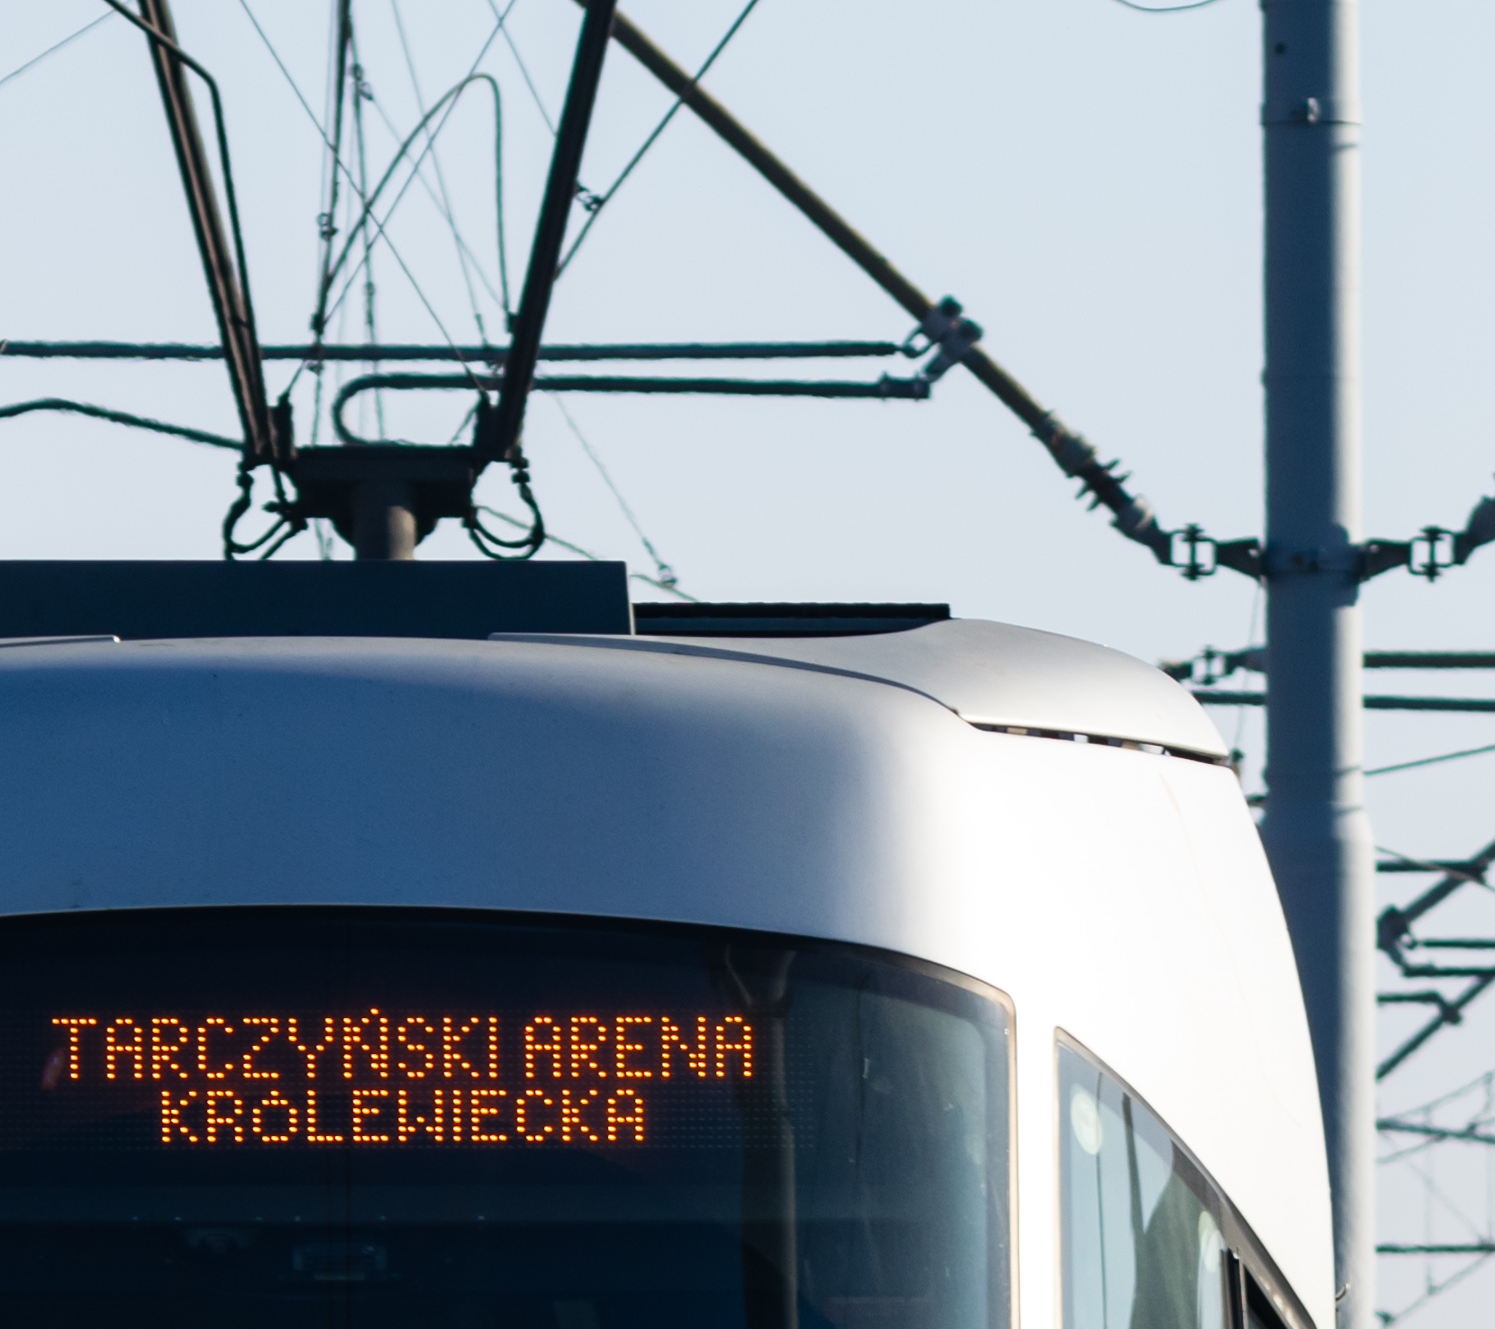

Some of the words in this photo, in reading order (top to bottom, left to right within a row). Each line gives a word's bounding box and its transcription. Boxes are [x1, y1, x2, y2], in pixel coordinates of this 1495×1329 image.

[51, 1007, 499, 1080] TARCZYŃSKI
[524, 1015, 753, 1080] ARENA
[161, 1088, 645, 1144] KRÓLEWIECKA
